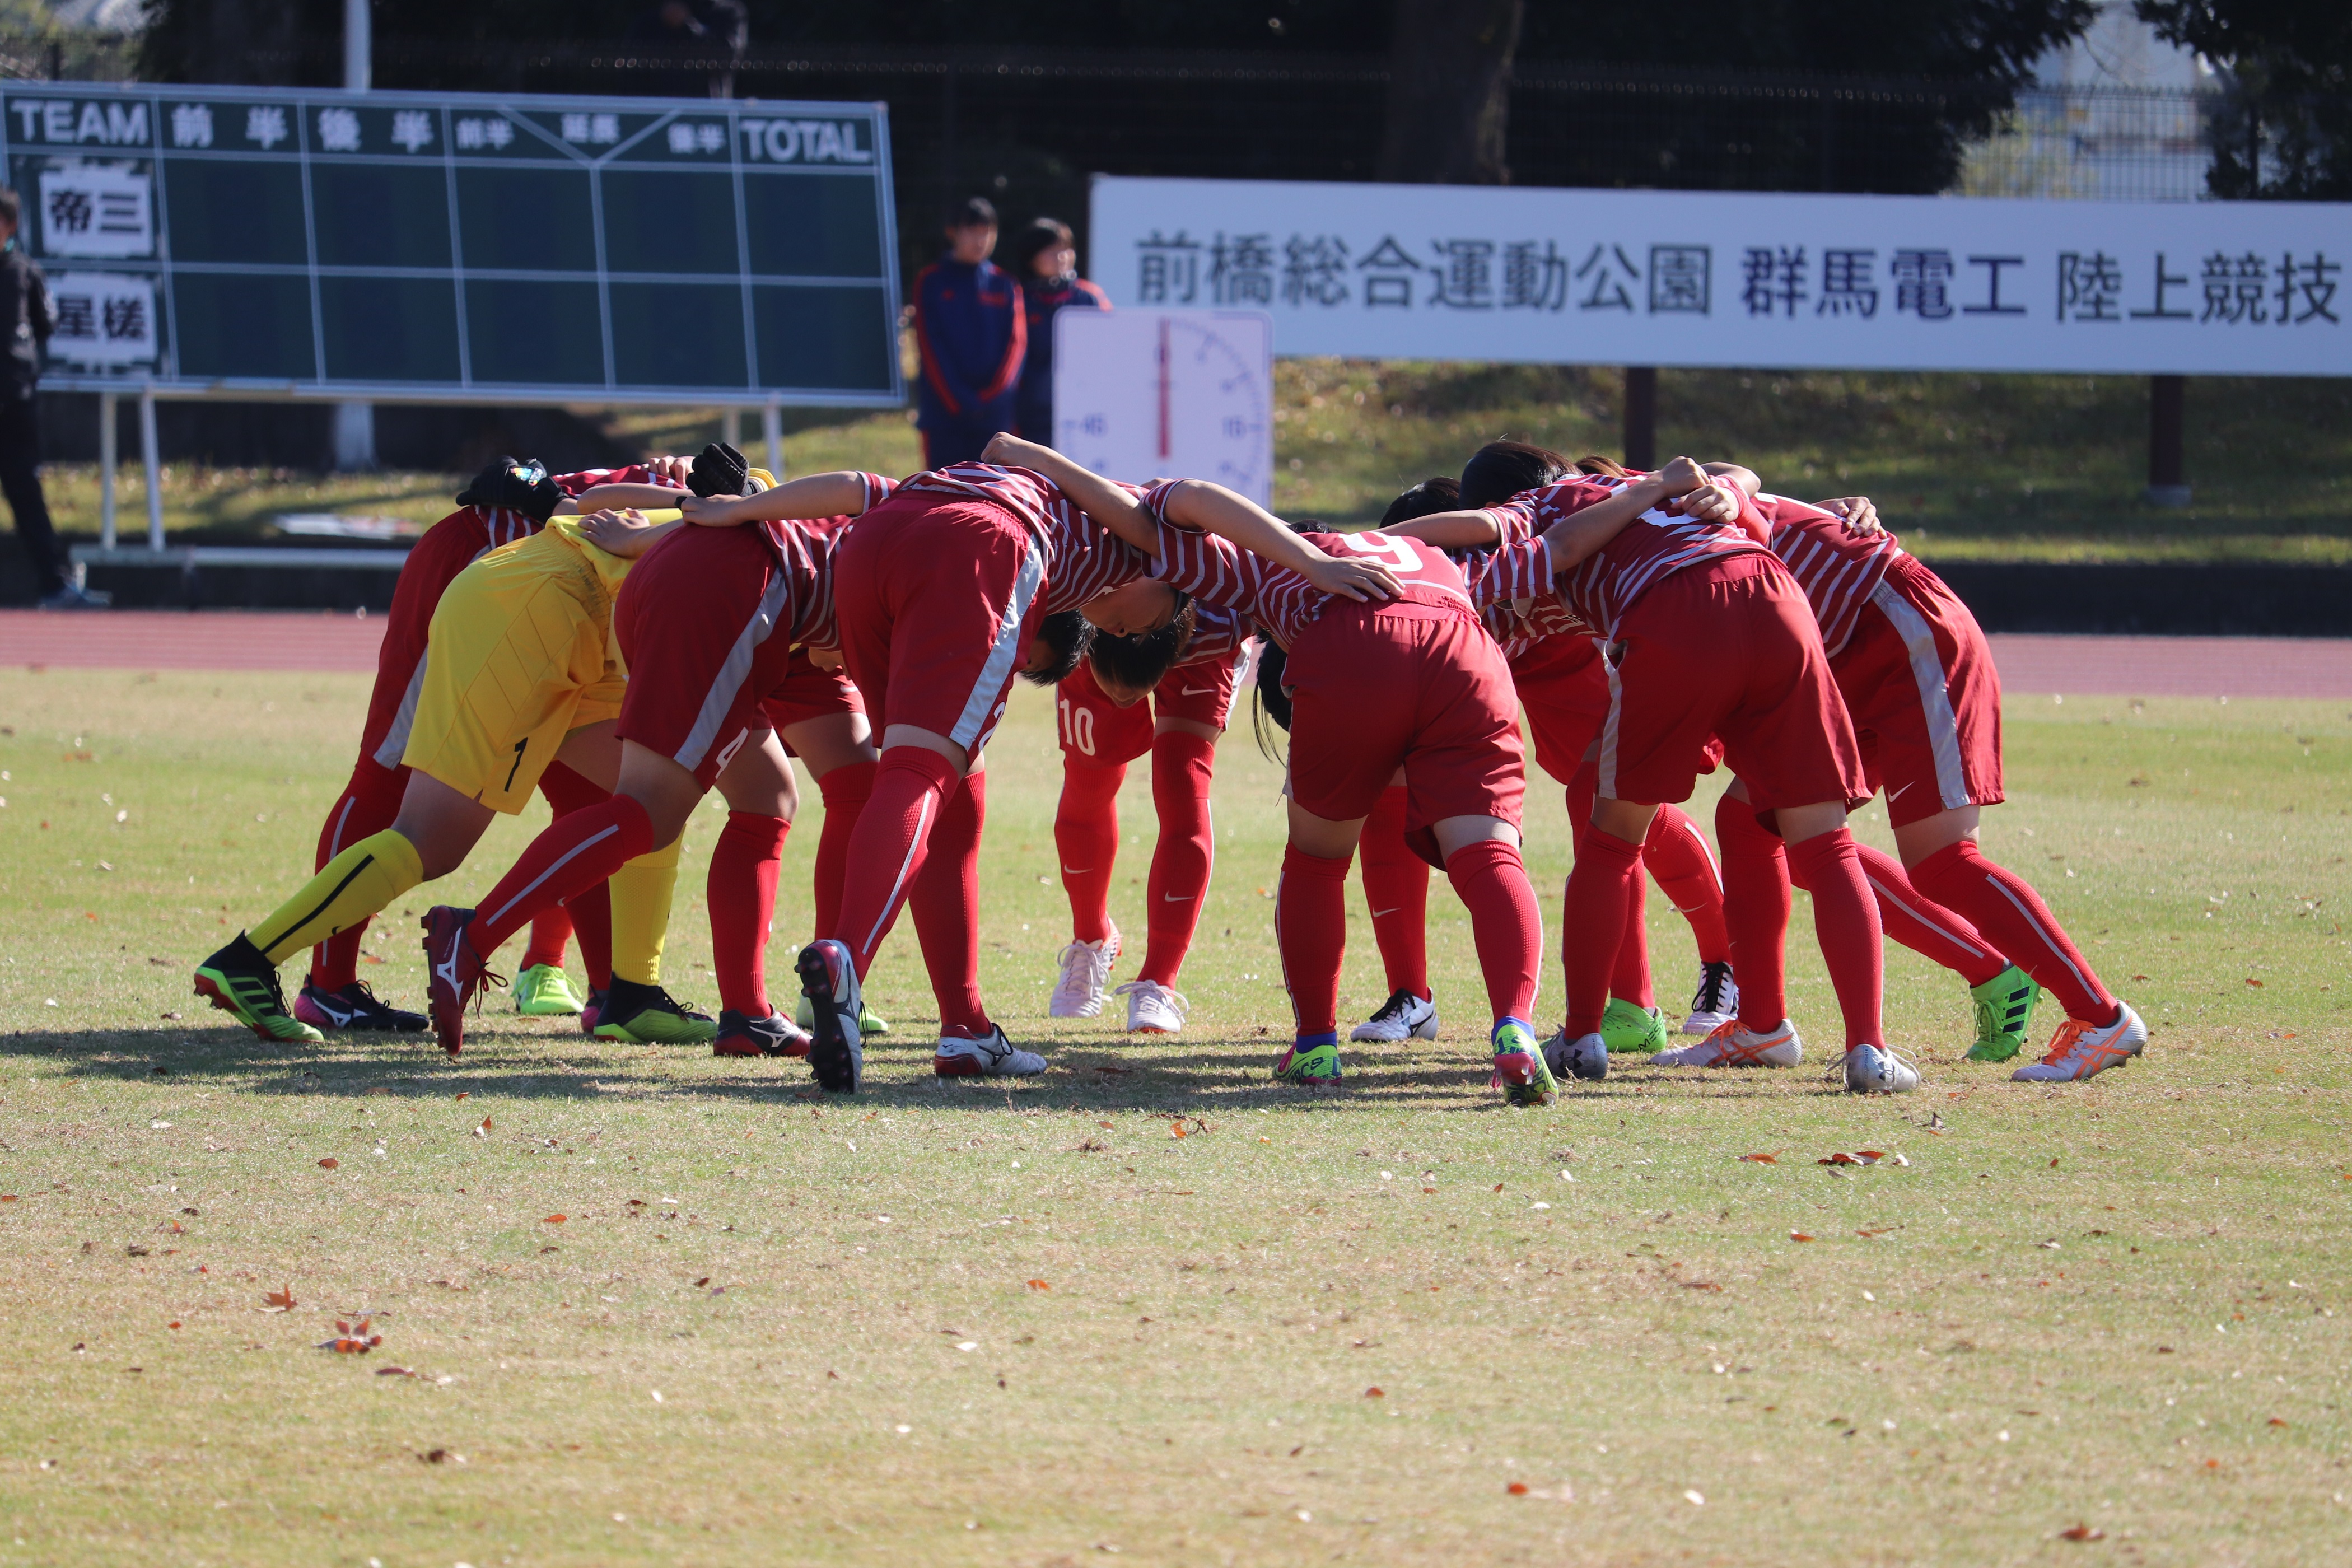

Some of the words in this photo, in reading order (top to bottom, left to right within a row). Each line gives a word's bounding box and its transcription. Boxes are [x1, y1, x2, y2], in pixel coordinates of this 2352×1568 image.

[11, 100, 150, 146] TEAM
[740, 119, 871, 163] TOTAL
[49, 189, 142, 235] 帝三
[1136, 230, 1711, 317] 前橋総合運動公園
[1740, 245, 2027, 319] 群馬電工
[2056, 250, 2342, 325] 陸上競技
[1338, 531, 1424, 572] 9
[1059, 698, 1096, 757] 10
[504, 736, 529, 792] 1
